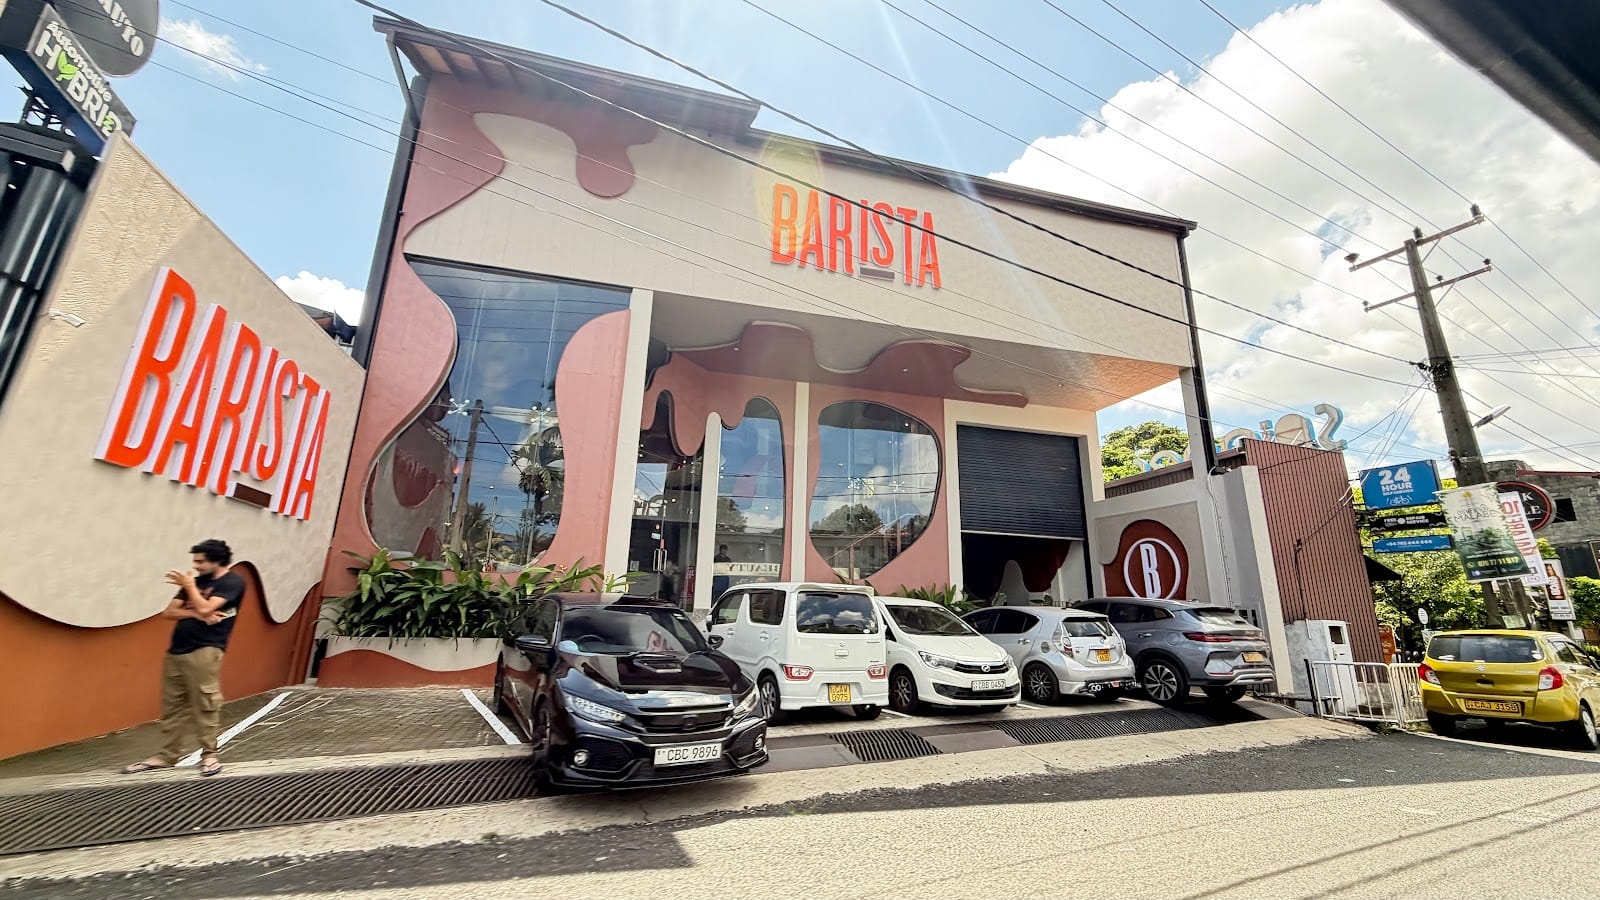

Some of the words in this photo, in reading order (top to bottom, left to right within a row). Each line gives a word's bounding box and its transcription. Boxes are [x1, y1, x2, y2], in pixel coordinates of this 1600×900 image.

[769, 183, 943, 289] BARISTA
[92, 266, 332, 521] BARISTA
[1378, 466, 1411, 485] 24
[1381, 482, 1414, 492] HOUR
[1140, 543, 1161, 599] B
[667, 748, 689, 761] CBC
[692, 746, 718, 760] 9896
